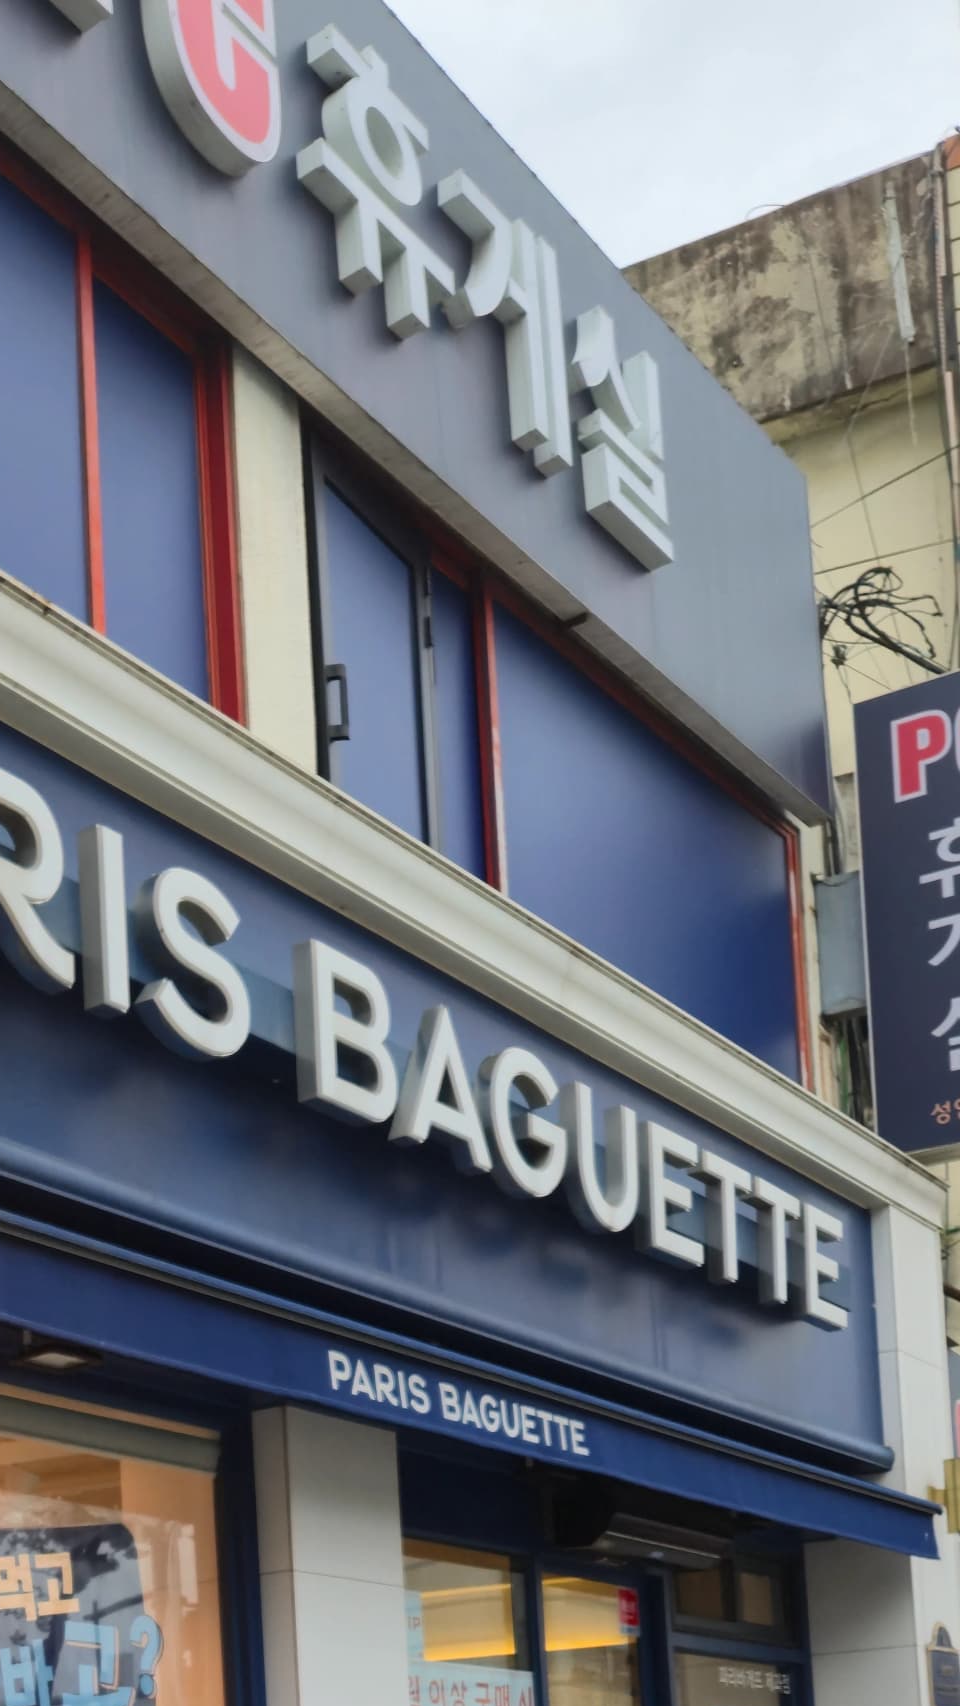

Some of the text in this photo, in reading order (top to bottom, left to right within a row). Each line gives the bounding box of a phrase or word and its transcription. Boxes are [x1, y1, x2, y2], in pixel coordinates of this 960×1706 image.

[890, 709, 960, 804] P
[293, 938, 851, 1331] BAGUETTE
[327, 1350, 590, 1456] PARIS BAGUETTE
